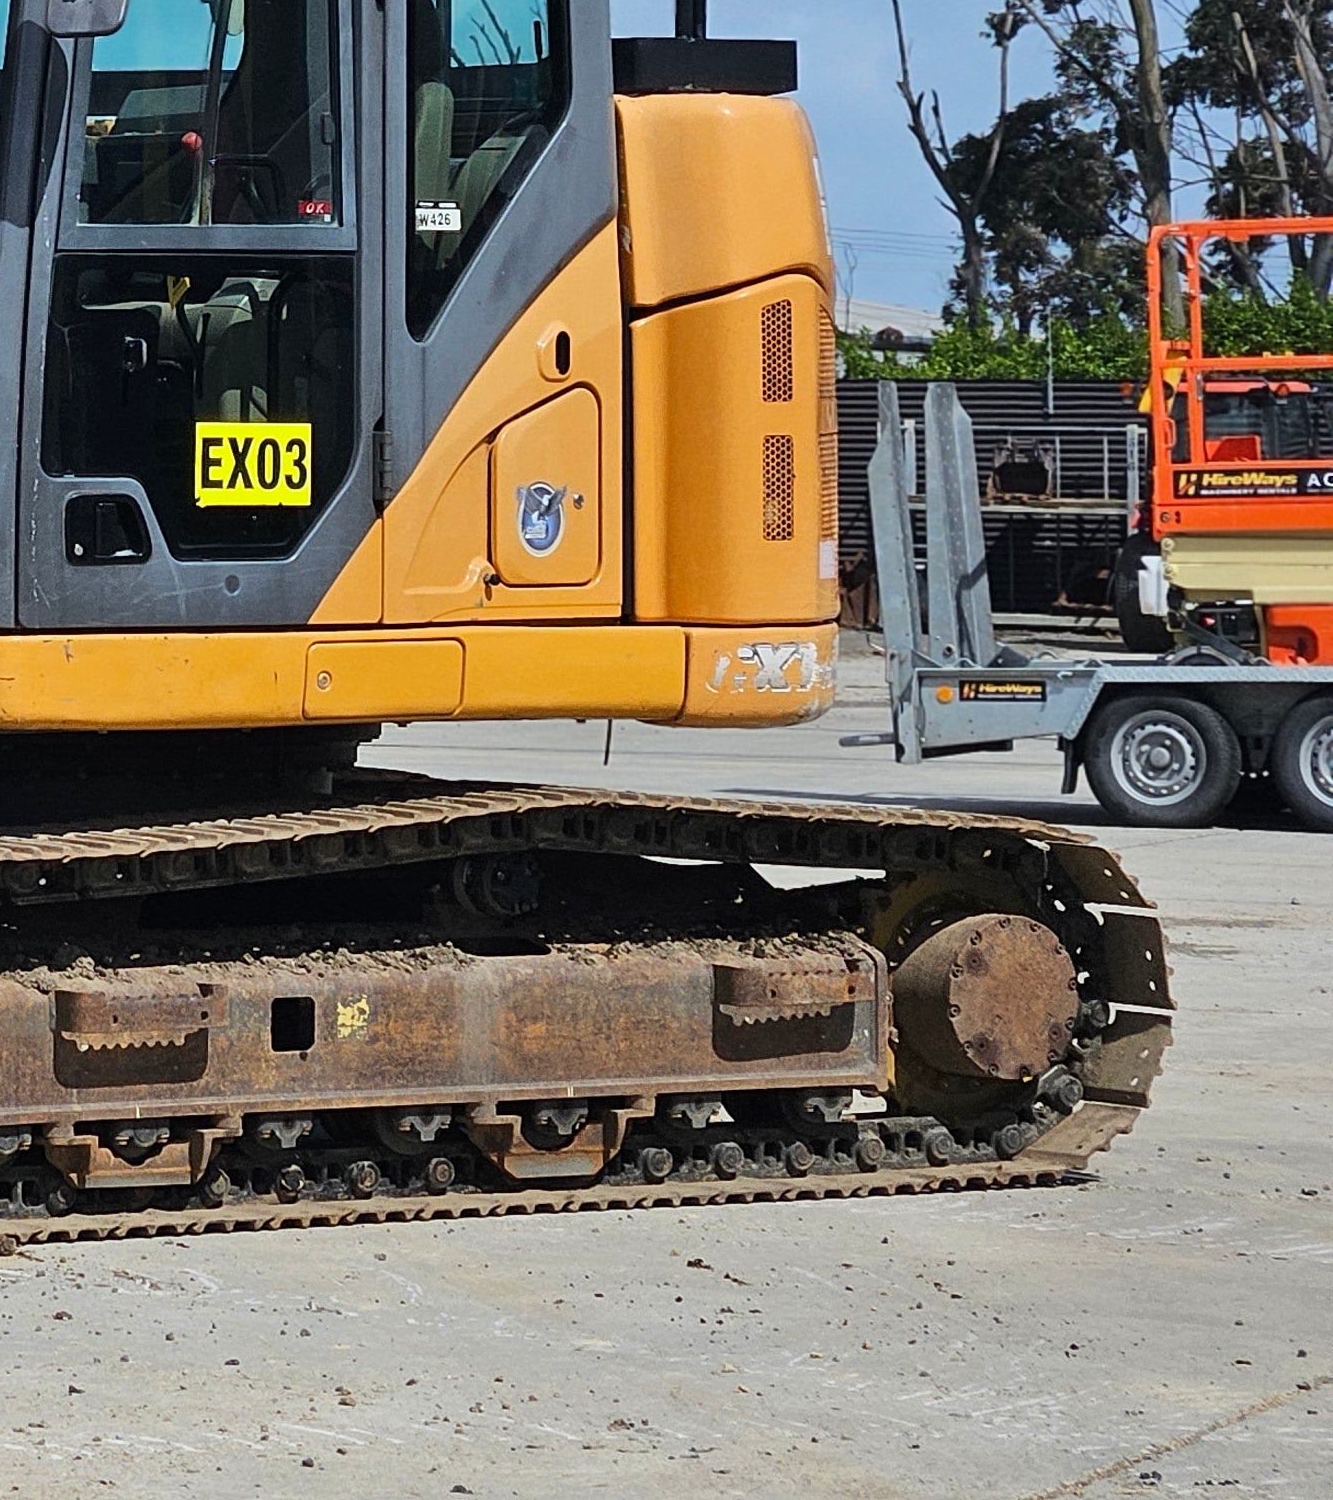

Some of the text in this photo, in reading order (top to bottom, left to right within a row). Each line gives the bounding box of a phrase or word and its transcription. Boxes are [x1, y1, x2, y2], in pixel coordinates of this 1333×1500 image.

[418, 212, 451, 227] W426
[201, 437, 308, 490] EX03
[1202, 472, 1298, 487] HireWays
